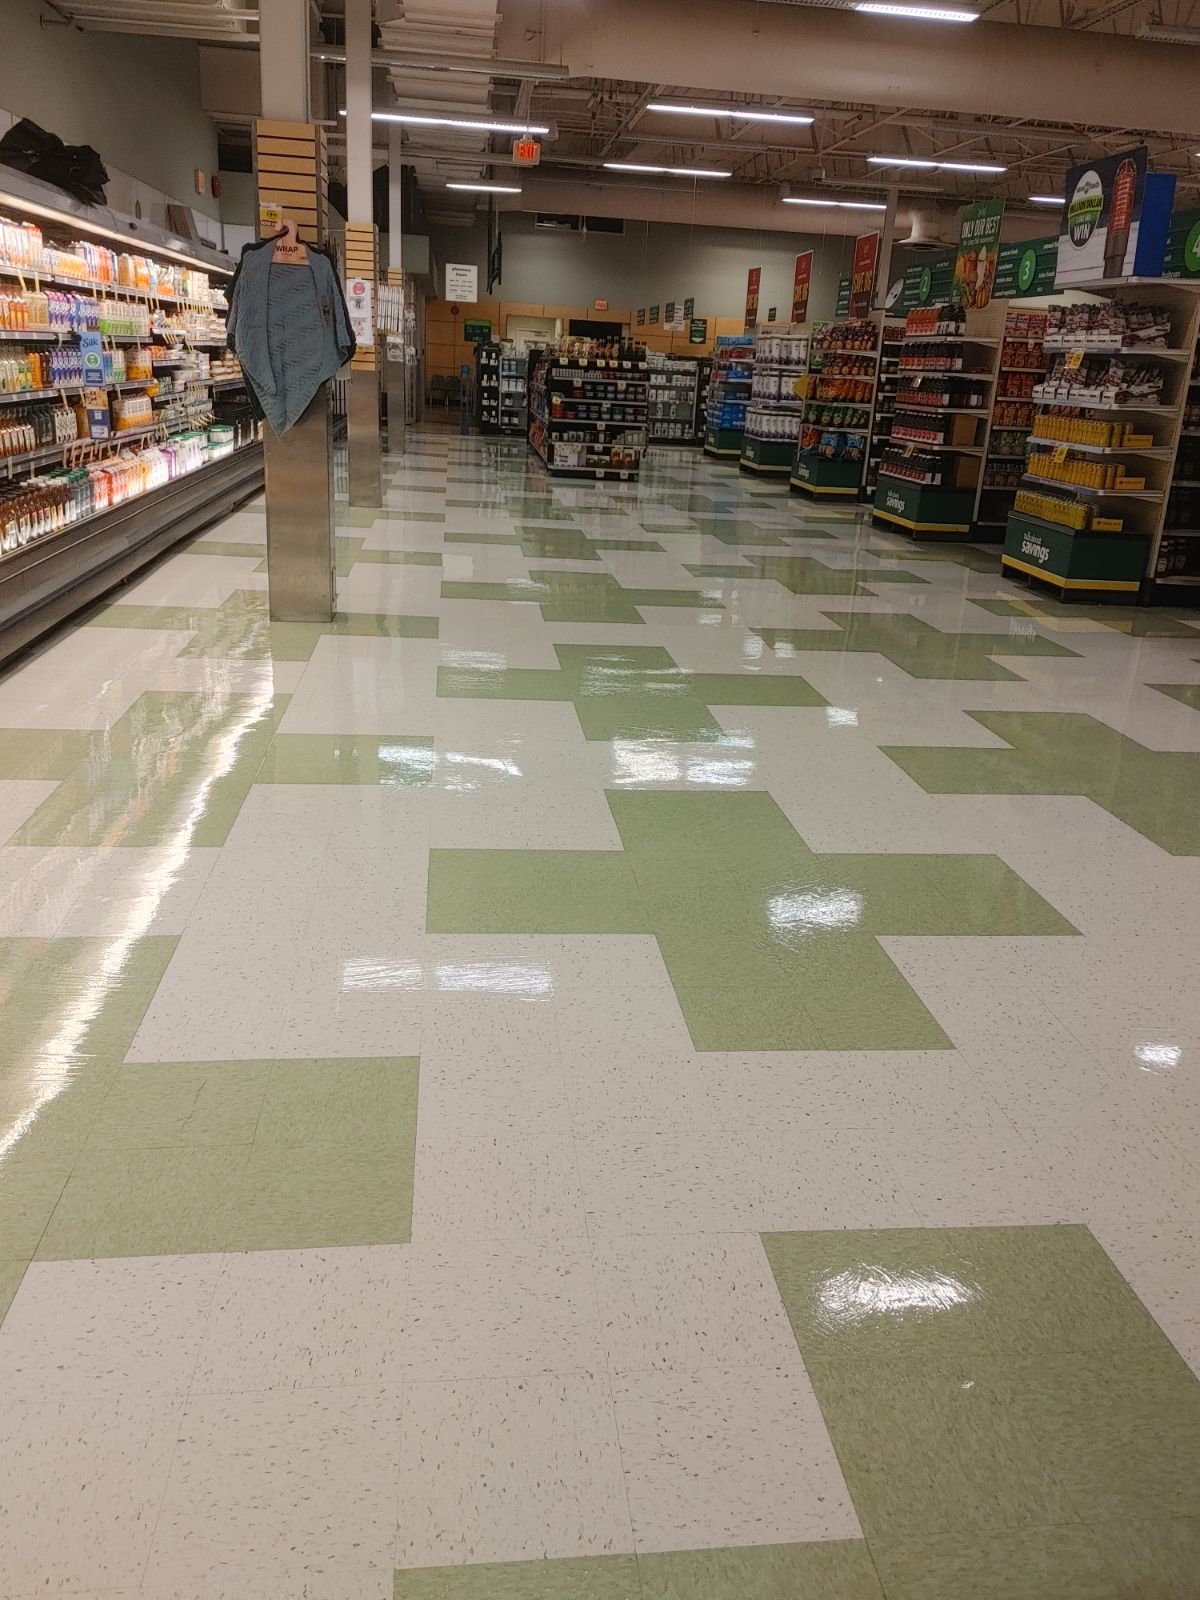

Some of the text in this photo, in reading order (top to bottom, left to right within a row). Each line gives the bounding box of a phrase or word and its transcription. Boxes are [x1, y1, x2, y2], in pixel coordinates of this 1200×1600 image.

[518, 143, 538, 160] EXIT
[974, 218, 986, 236] OUR
[985, 216, 1000, 234] BEST
[1074, 223, 1091, 240] WIN
[1022, 261, 1030, 280] 3
[922, 276, 928, 292] 2
[83, 336, 98, 347] Silk
[886, 496, 905, 513] savings
[1021, 540, 1050, 563] savings
